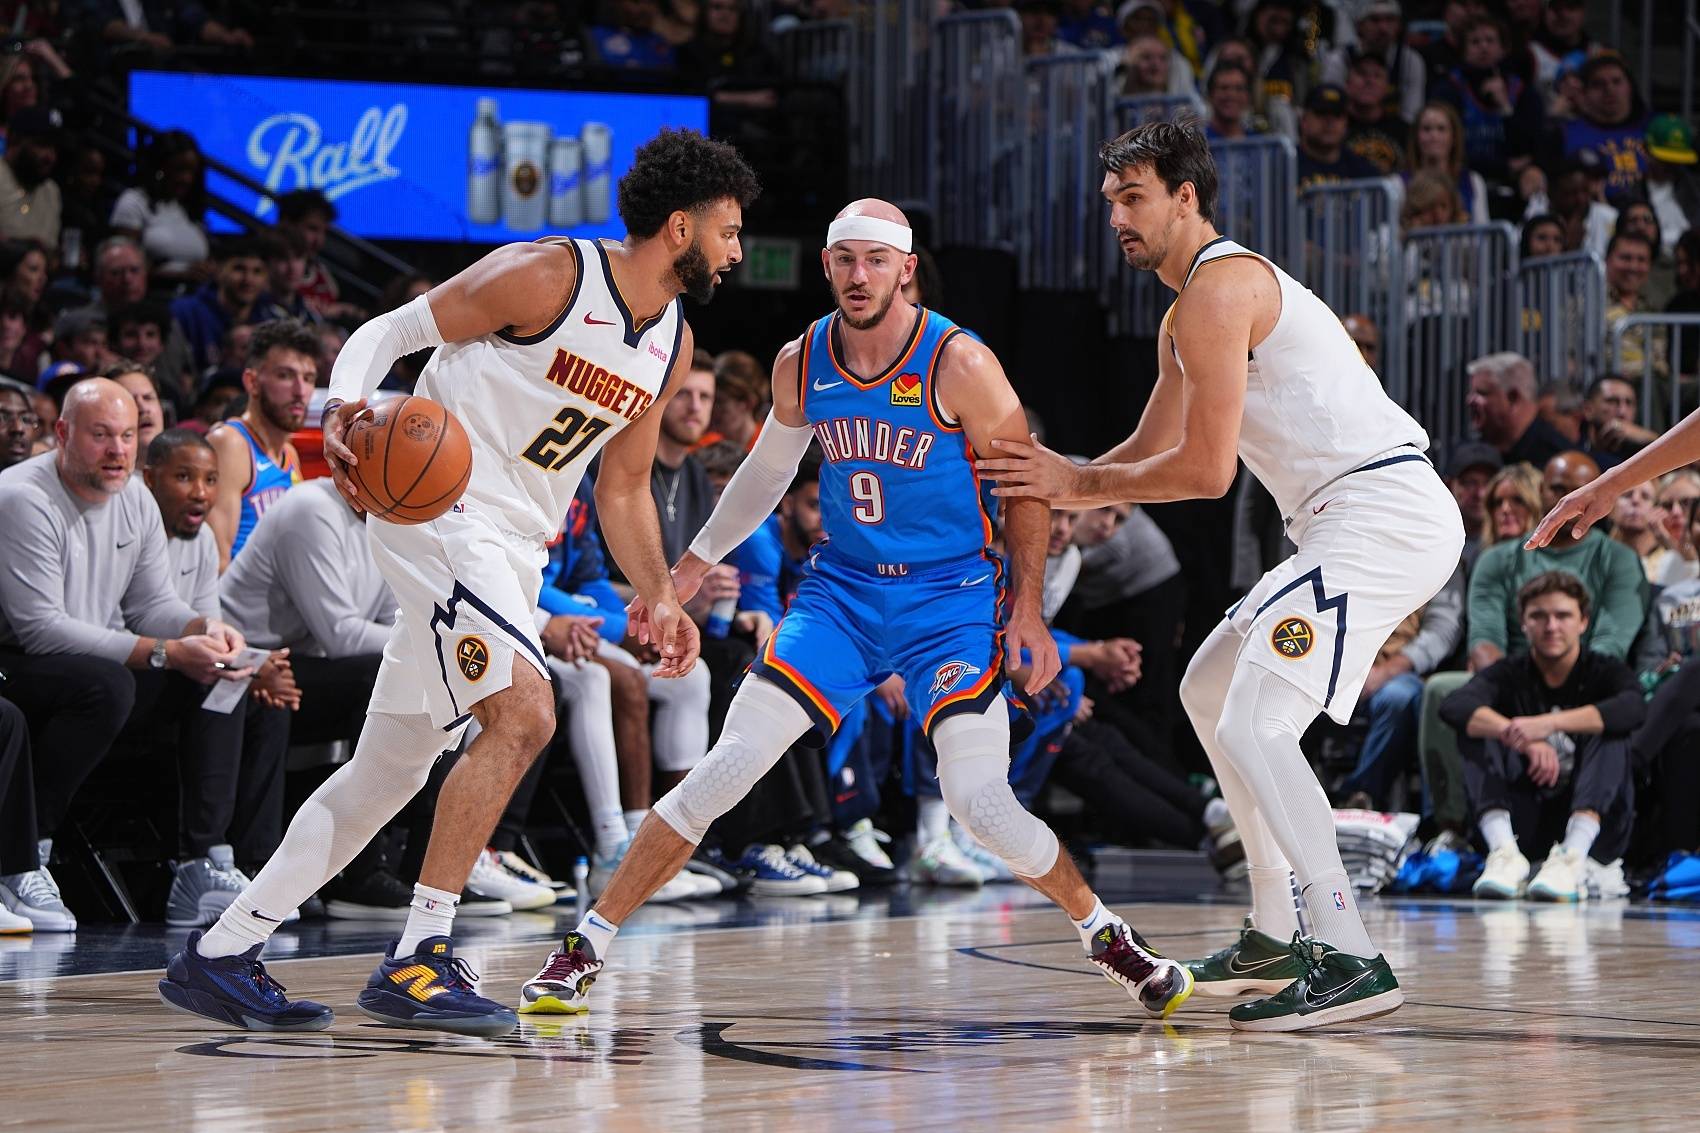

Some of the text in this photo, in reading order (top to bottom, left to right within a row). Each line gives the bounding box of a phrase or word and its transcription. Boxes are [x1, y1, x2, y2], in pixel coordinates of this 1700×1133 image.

[247, 102, 408, 218] Ball
[648, 340, 668, 363] ibotta
[545, 347, 654, 422] NUGGETS
[892, 393, 921, 404] Love's
[520, 406, 614, 473] 27
[812, 417, 935, 470] HUNDER
[849, 470, 885, 525] 9
